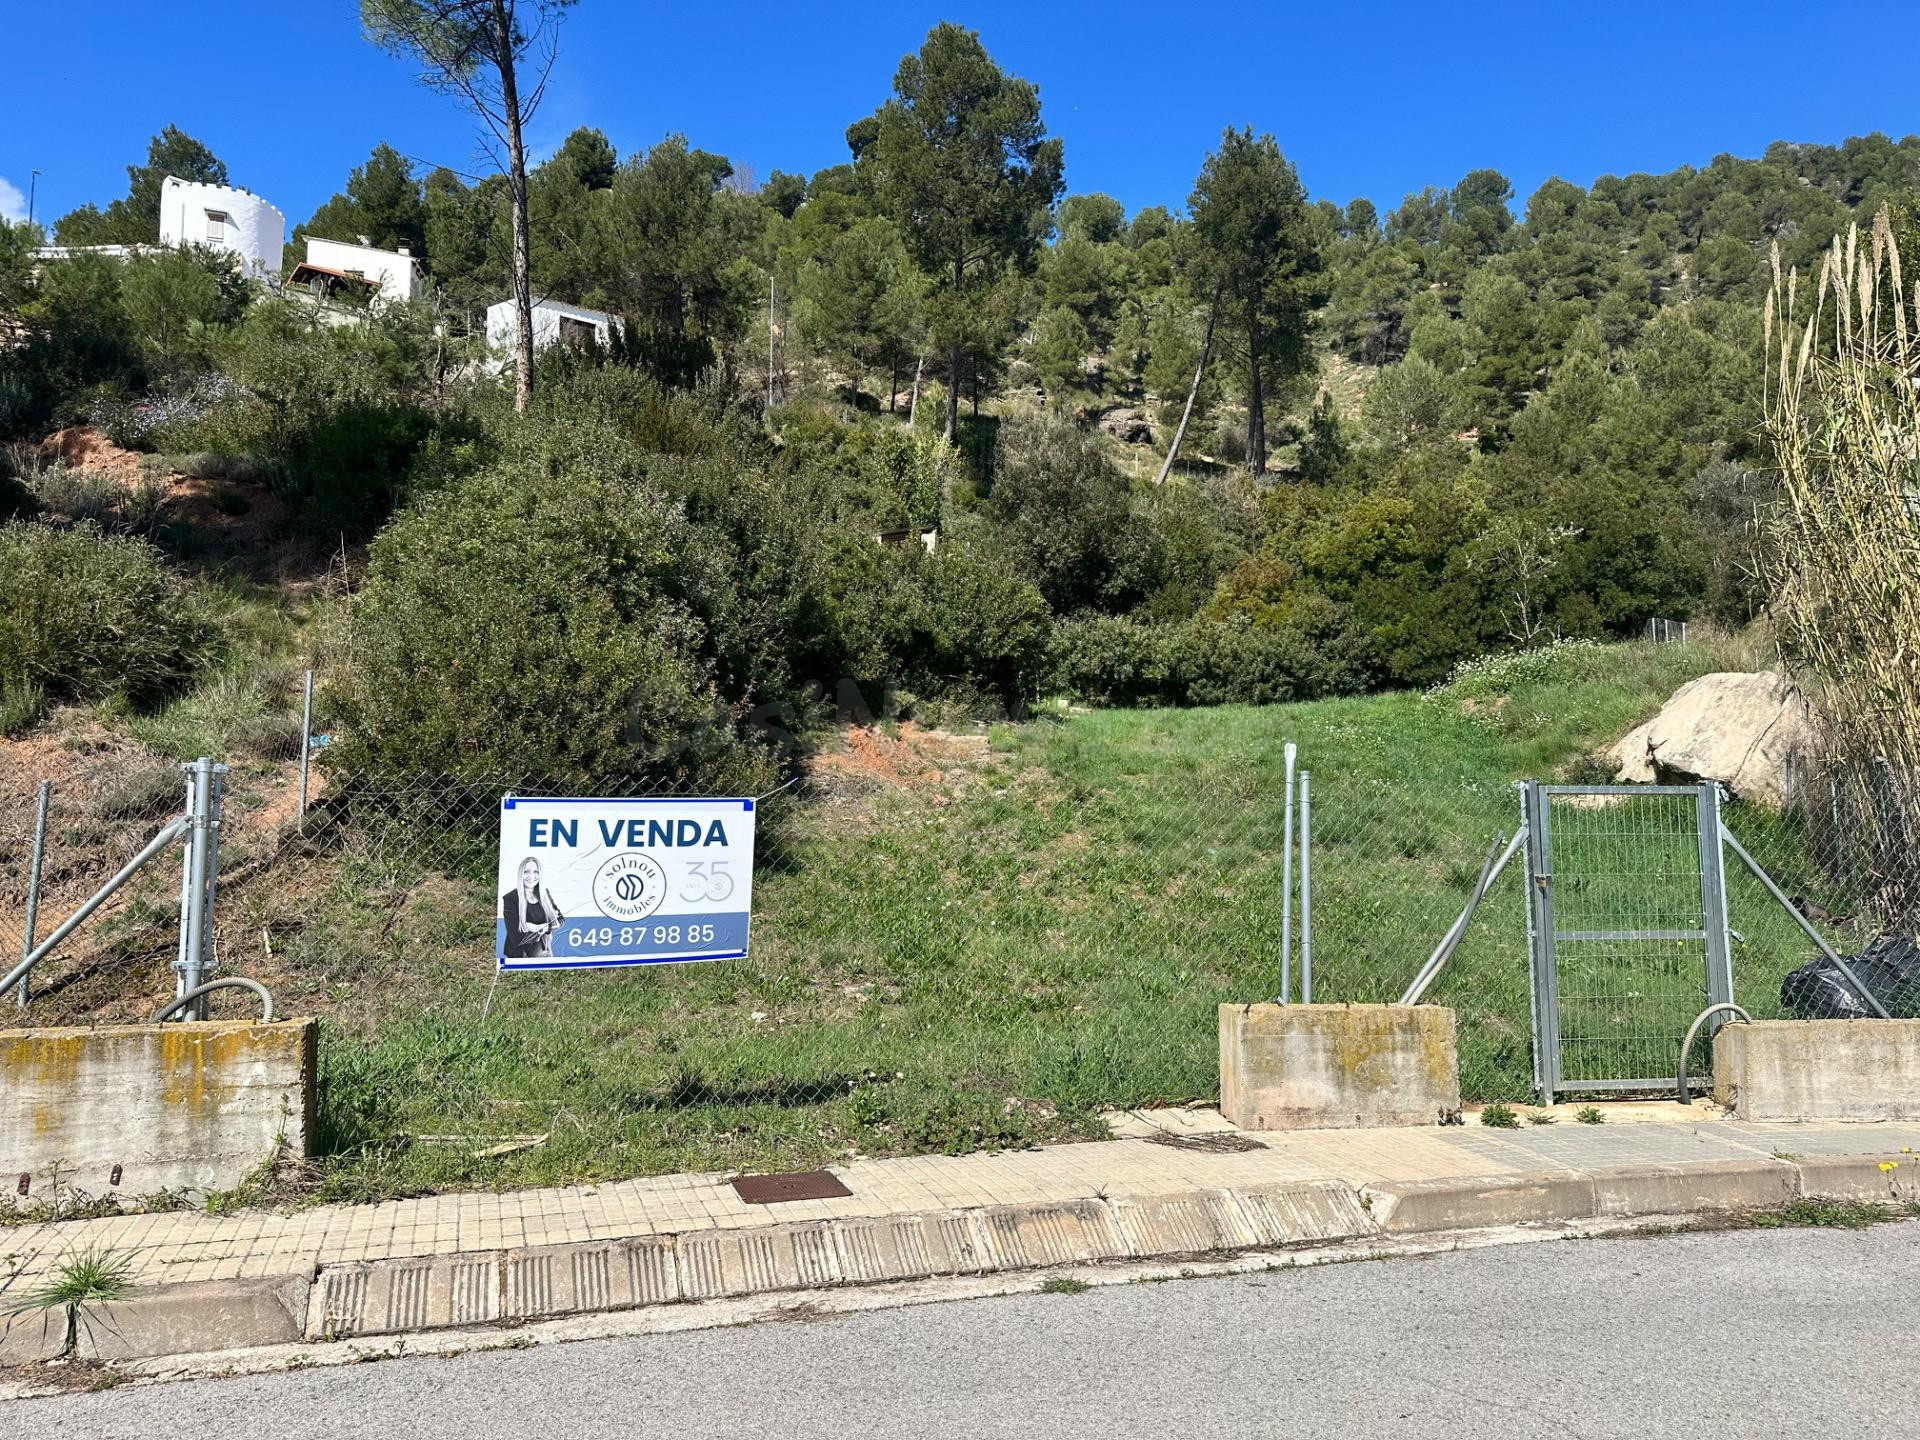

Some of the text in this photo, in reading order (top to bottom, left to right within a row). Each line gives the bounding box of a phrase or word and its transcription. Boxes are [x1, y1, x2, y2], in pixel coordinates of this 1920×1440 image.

[529, 818, 729, 848] EN VENDA
[605, 857, 656, 878] solnou
[680, 861, 734, 903] 35
[603, 895, 656, 915] immobles
[568, 924, 714, 947] 649 87 98 85
